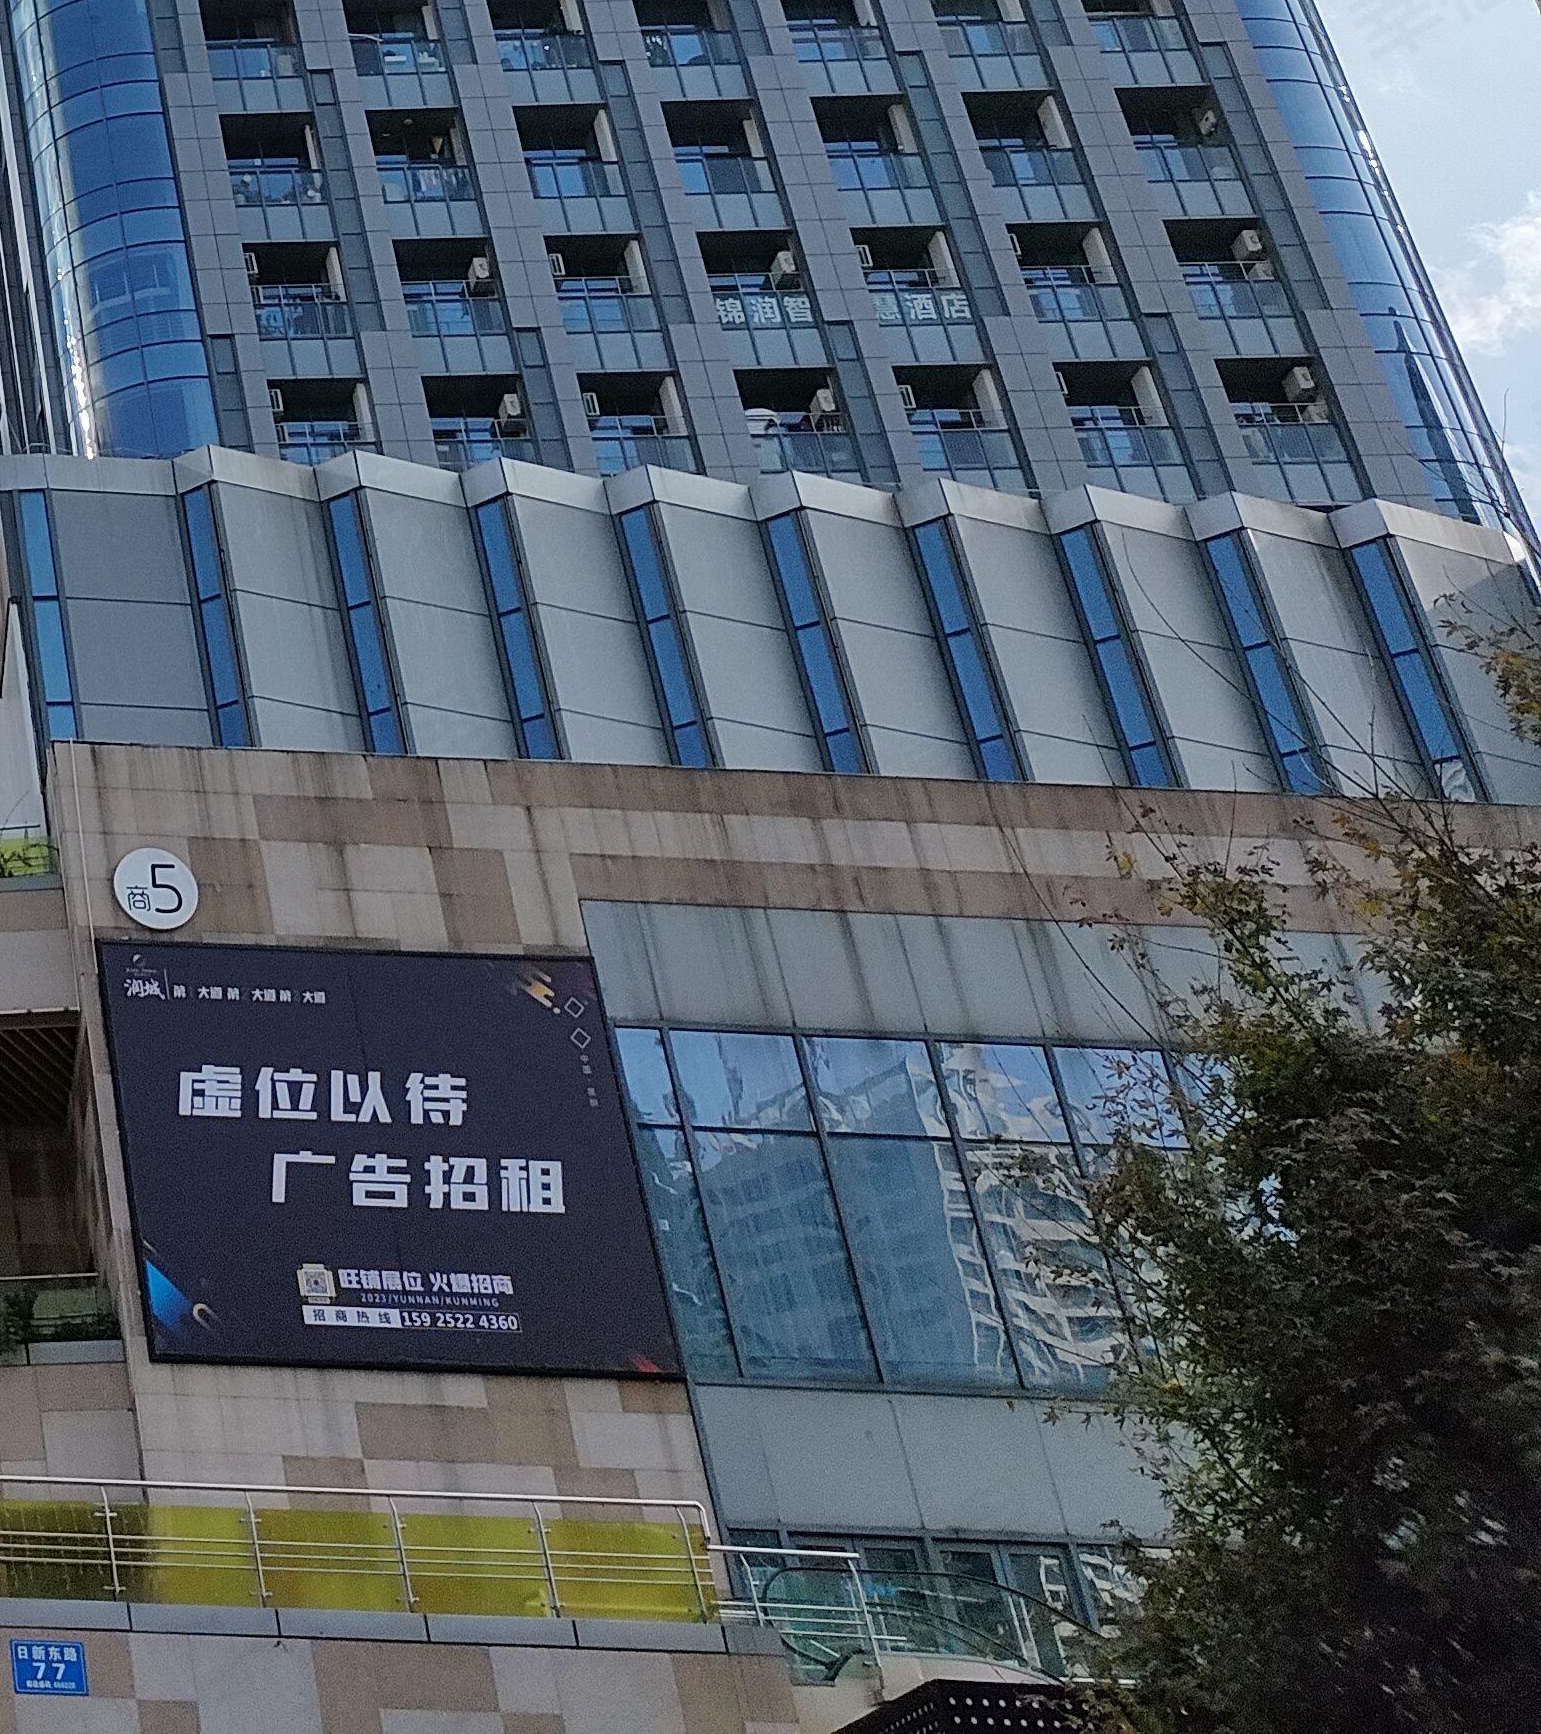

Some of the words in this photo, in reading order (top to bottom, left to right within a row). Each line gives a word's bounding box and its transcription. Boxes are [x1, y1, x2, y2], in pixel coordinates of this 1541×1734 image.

[177, 1064, 468, 1126] 虚位以待
[270, 1150, 566, 1214] 广告招租
[402, 1311, 431, 1327] 159
[435, 1312, 475, 1328] 2522
[478, 1314, 518, 1330] 4360
[17, 1645, 77, 1662] 日新东路
